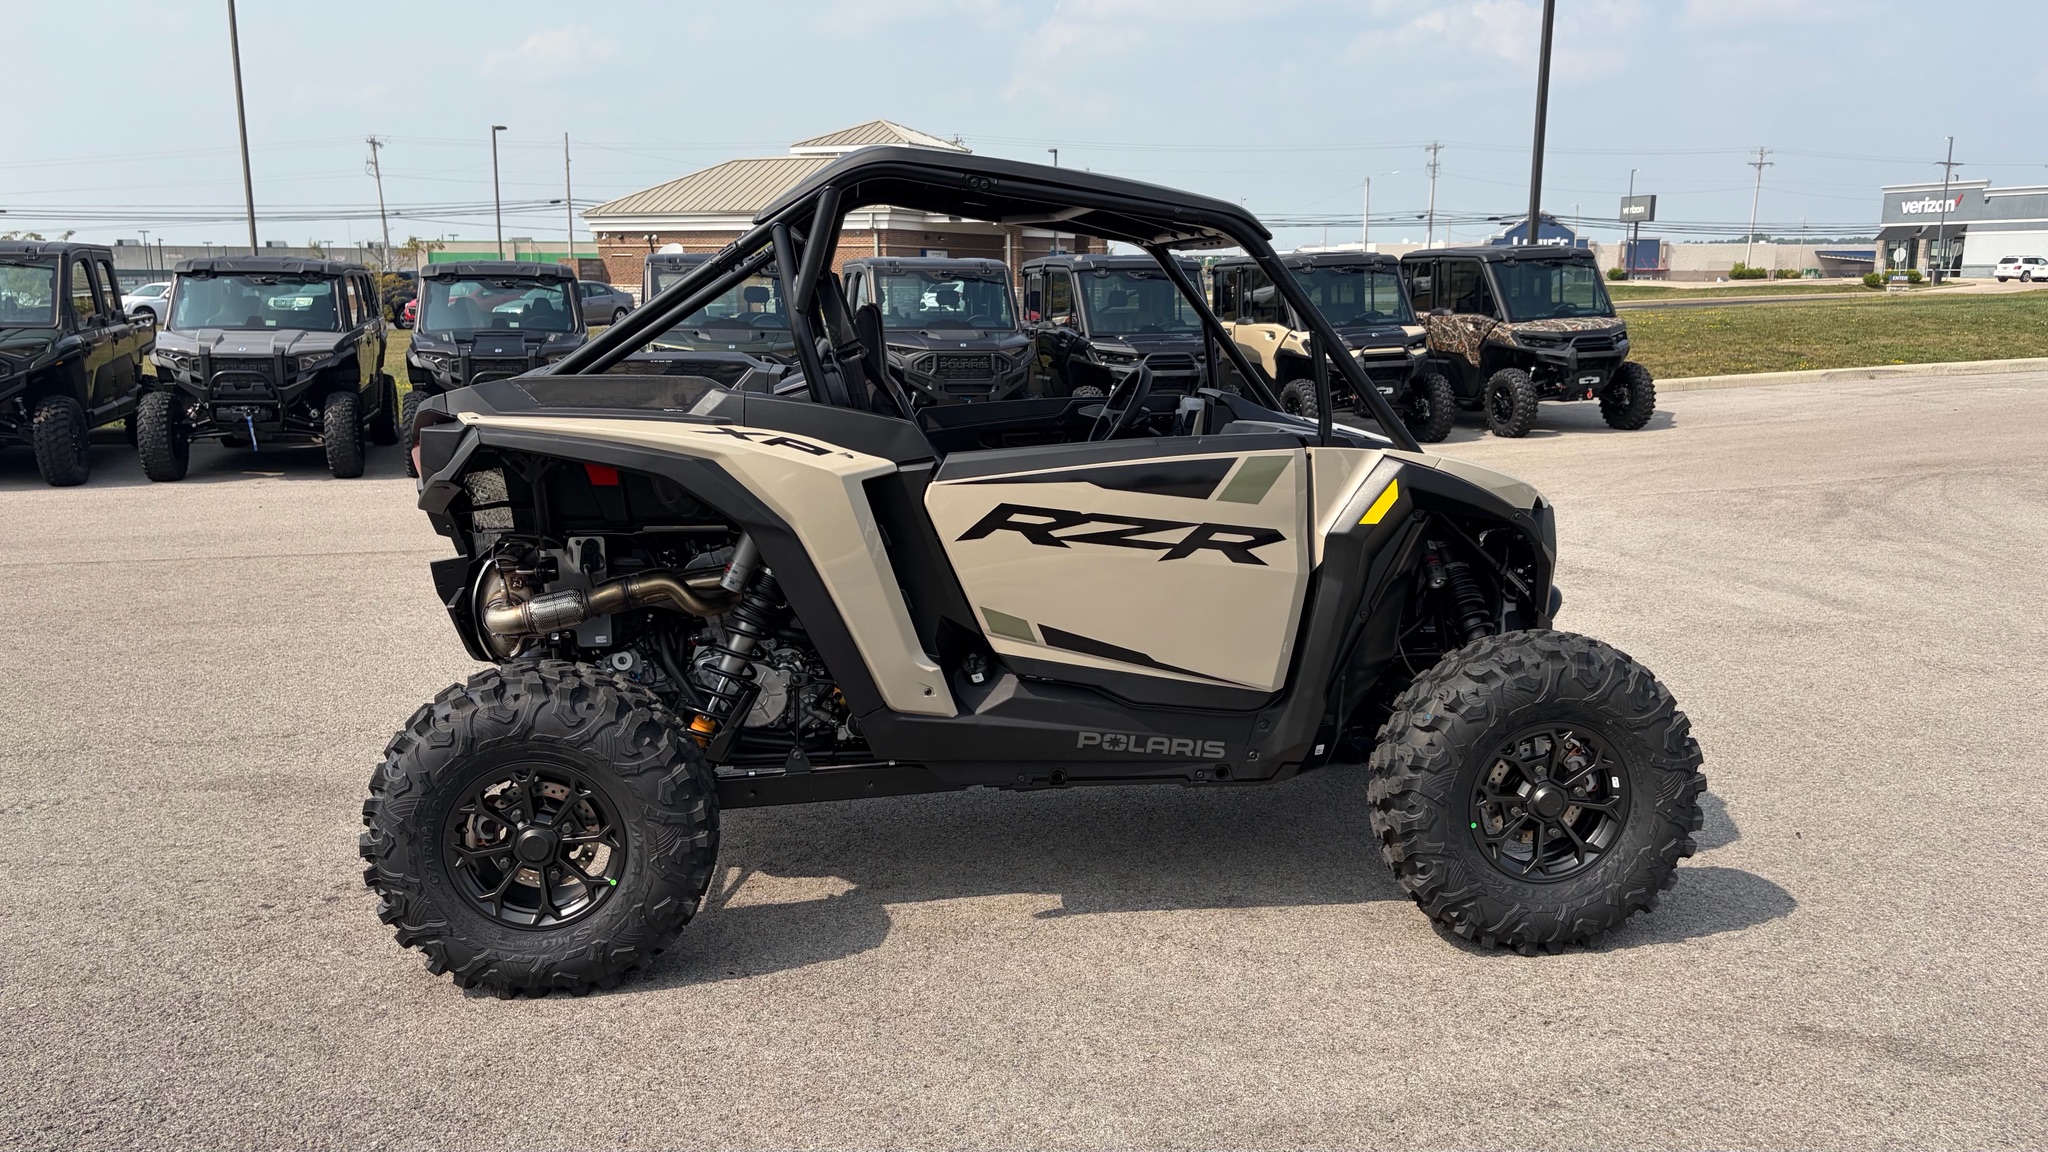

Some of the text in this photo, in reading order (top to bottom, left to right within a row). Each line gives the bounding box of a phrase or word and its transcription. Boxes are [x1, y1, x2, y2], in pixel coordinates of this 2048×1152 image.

[1622, 205, 1645, 216] verizon
[1901, 196, 1956, 216] verizon
[939, 361, 990, 370] POLARIS
[688, 426, 834, 456] XP
[954, 502, 1287, 567] RZR
[1076, 731, 1226, 760] POLARIS
